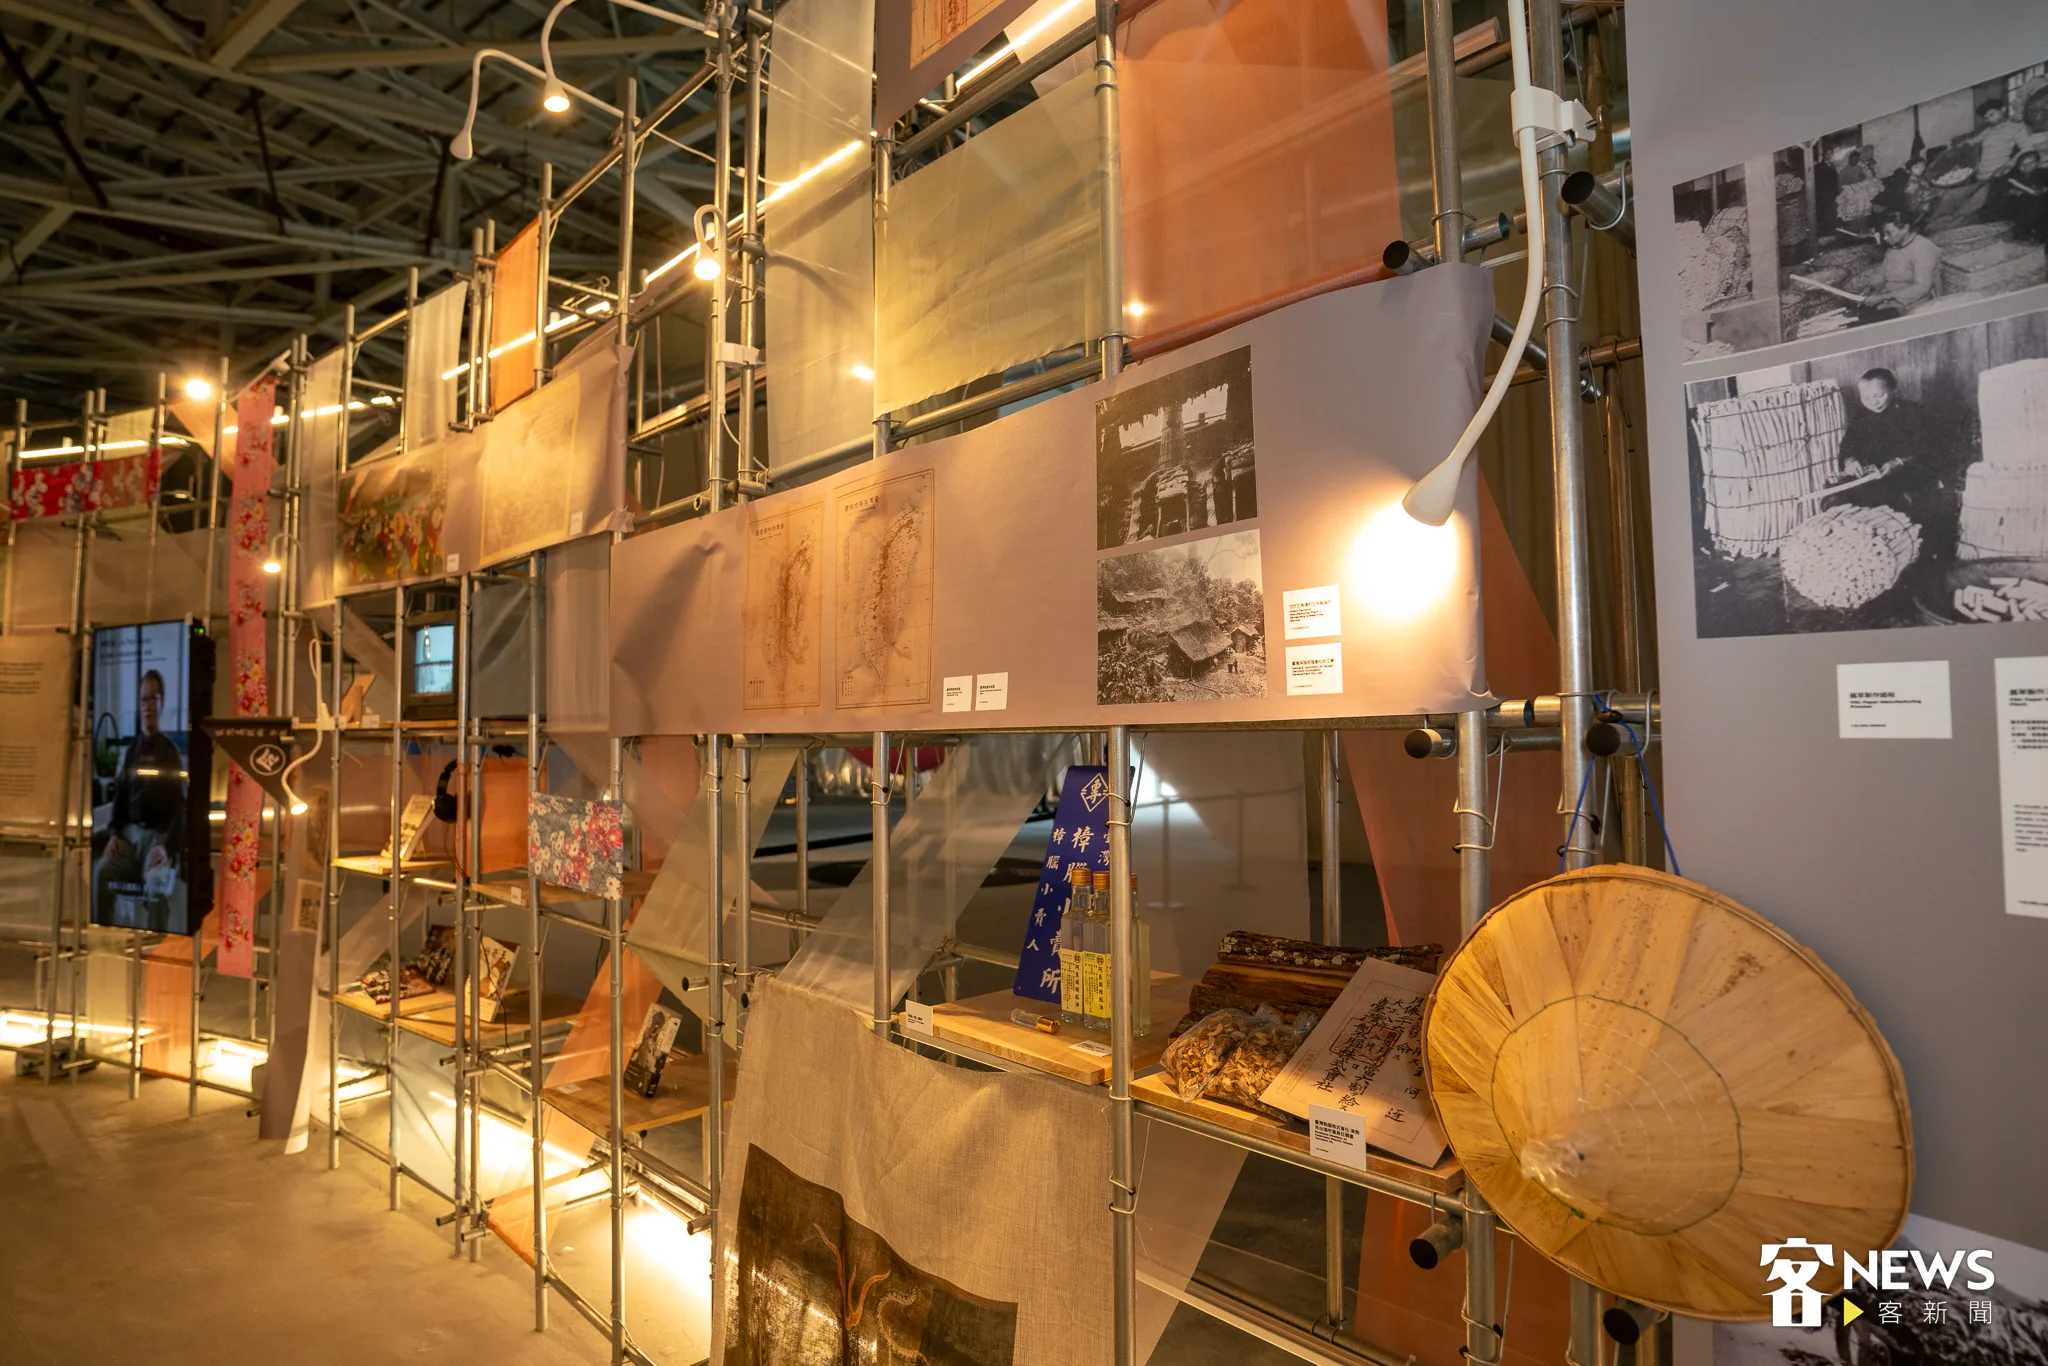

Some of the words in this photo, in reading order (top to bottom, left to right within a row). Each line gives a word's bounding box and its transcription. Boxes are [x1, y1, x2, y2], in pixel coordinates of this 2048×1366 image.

[1026, 827, 1067, 952] 樟腦小賣人
